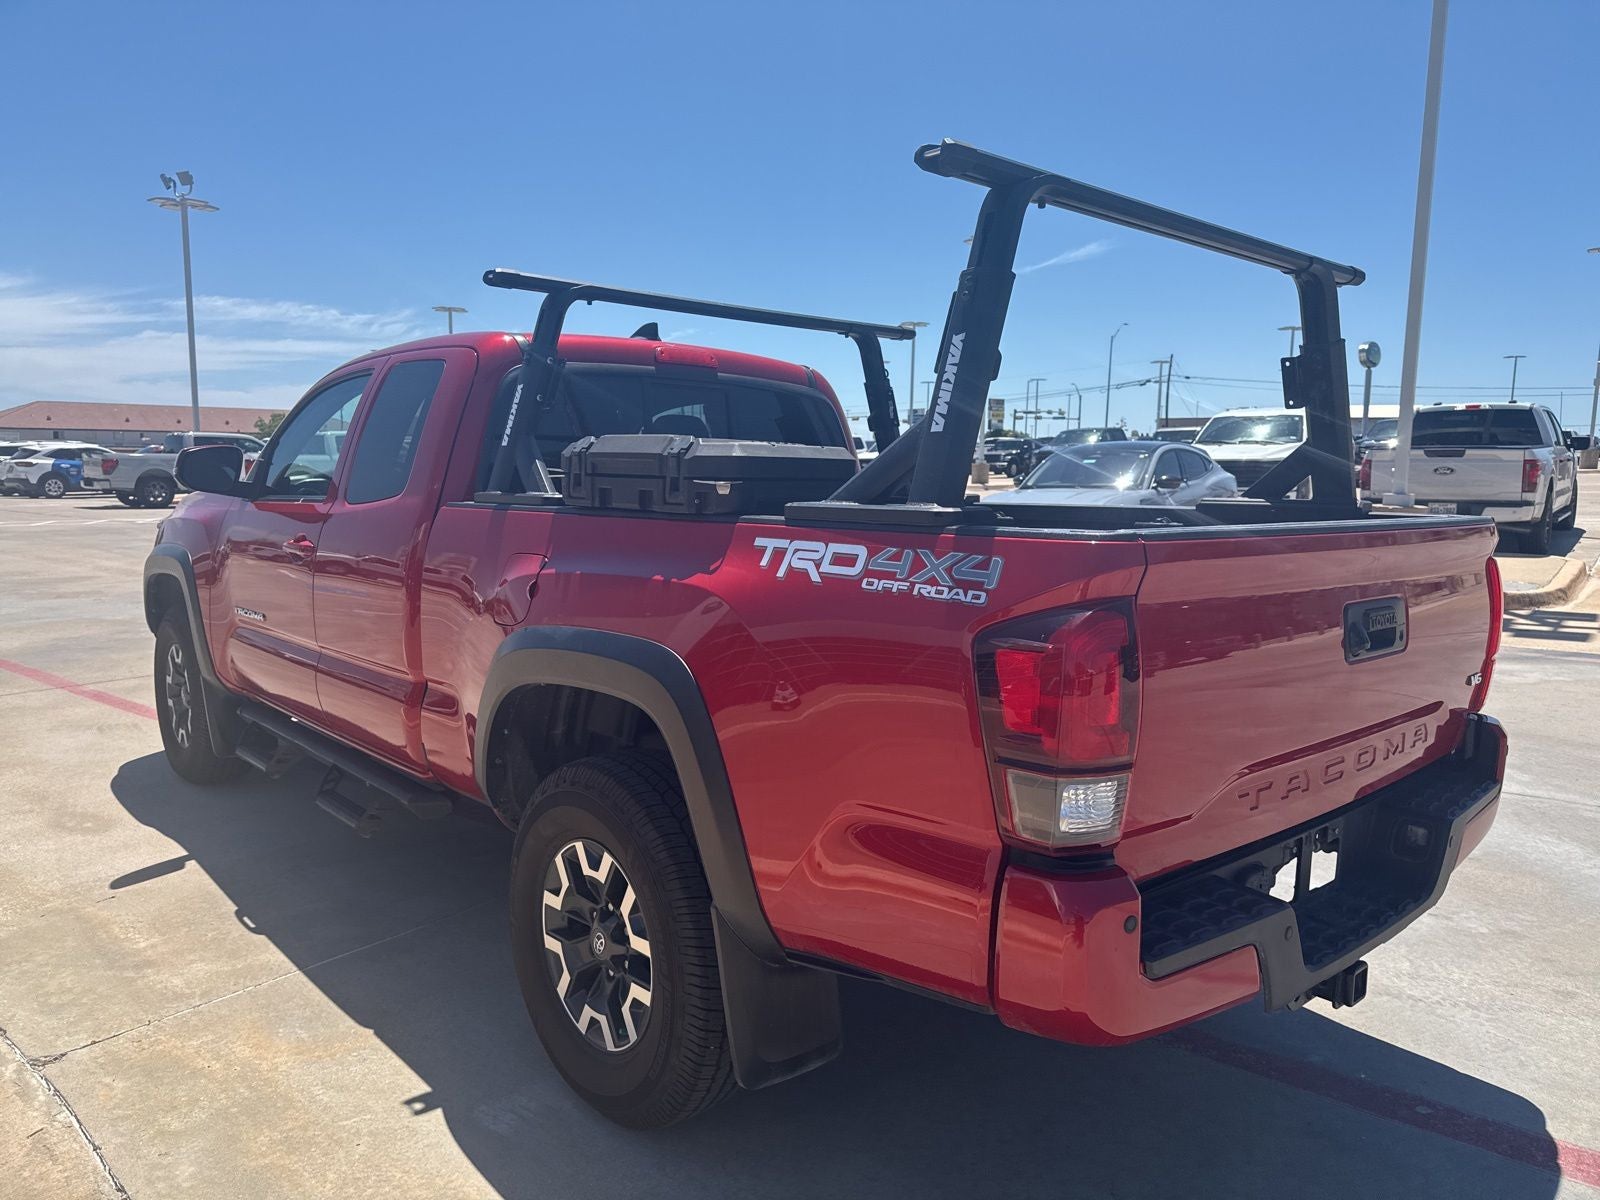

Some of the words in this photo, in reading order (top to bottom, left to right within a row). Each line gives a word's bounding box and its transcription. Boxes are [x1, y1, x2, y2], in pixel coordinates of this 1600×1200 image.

[930, 332, 966, 432] YAKIMA
[501, 383, 524, 446] YAKIMA
[753, 537, 867, 583] TRD
[234, 606, 266, 622] TACOMA
[861, 577, 911, 594] OFF
[912, 584, 988, 606] ROAD
[1371, 613, 1398, 629] TOYOTA
[1237, 723, 1429, 812] TACOMA
